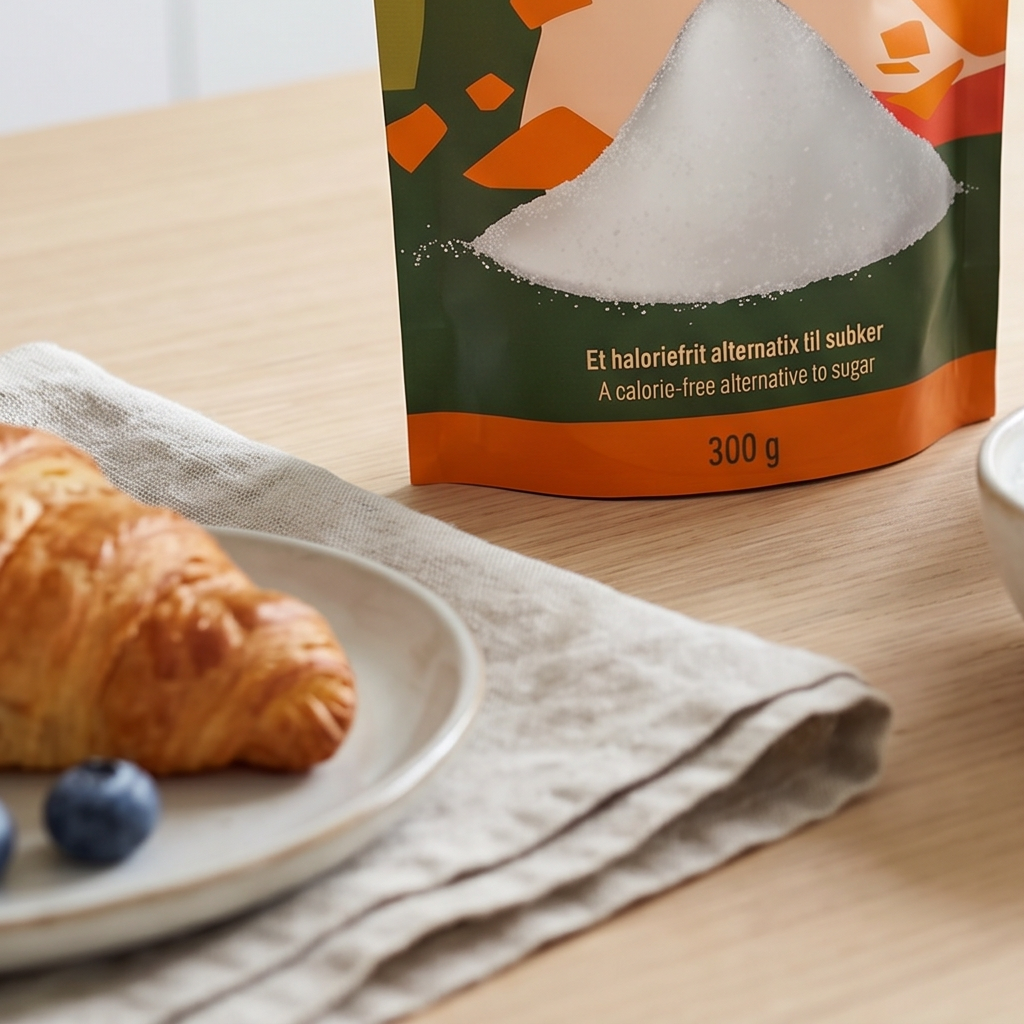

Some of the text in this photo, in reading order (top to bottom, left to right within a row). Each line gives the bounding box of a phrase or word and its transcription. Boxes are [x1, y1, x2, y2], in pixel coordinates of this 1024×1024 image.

[586, 349, 606, 371] Et
[803, 329, 821, 353] til
[598, 355, 875, 402] A calorie-free alternative to sugar
[708, 432, 780, 468] 300 g
